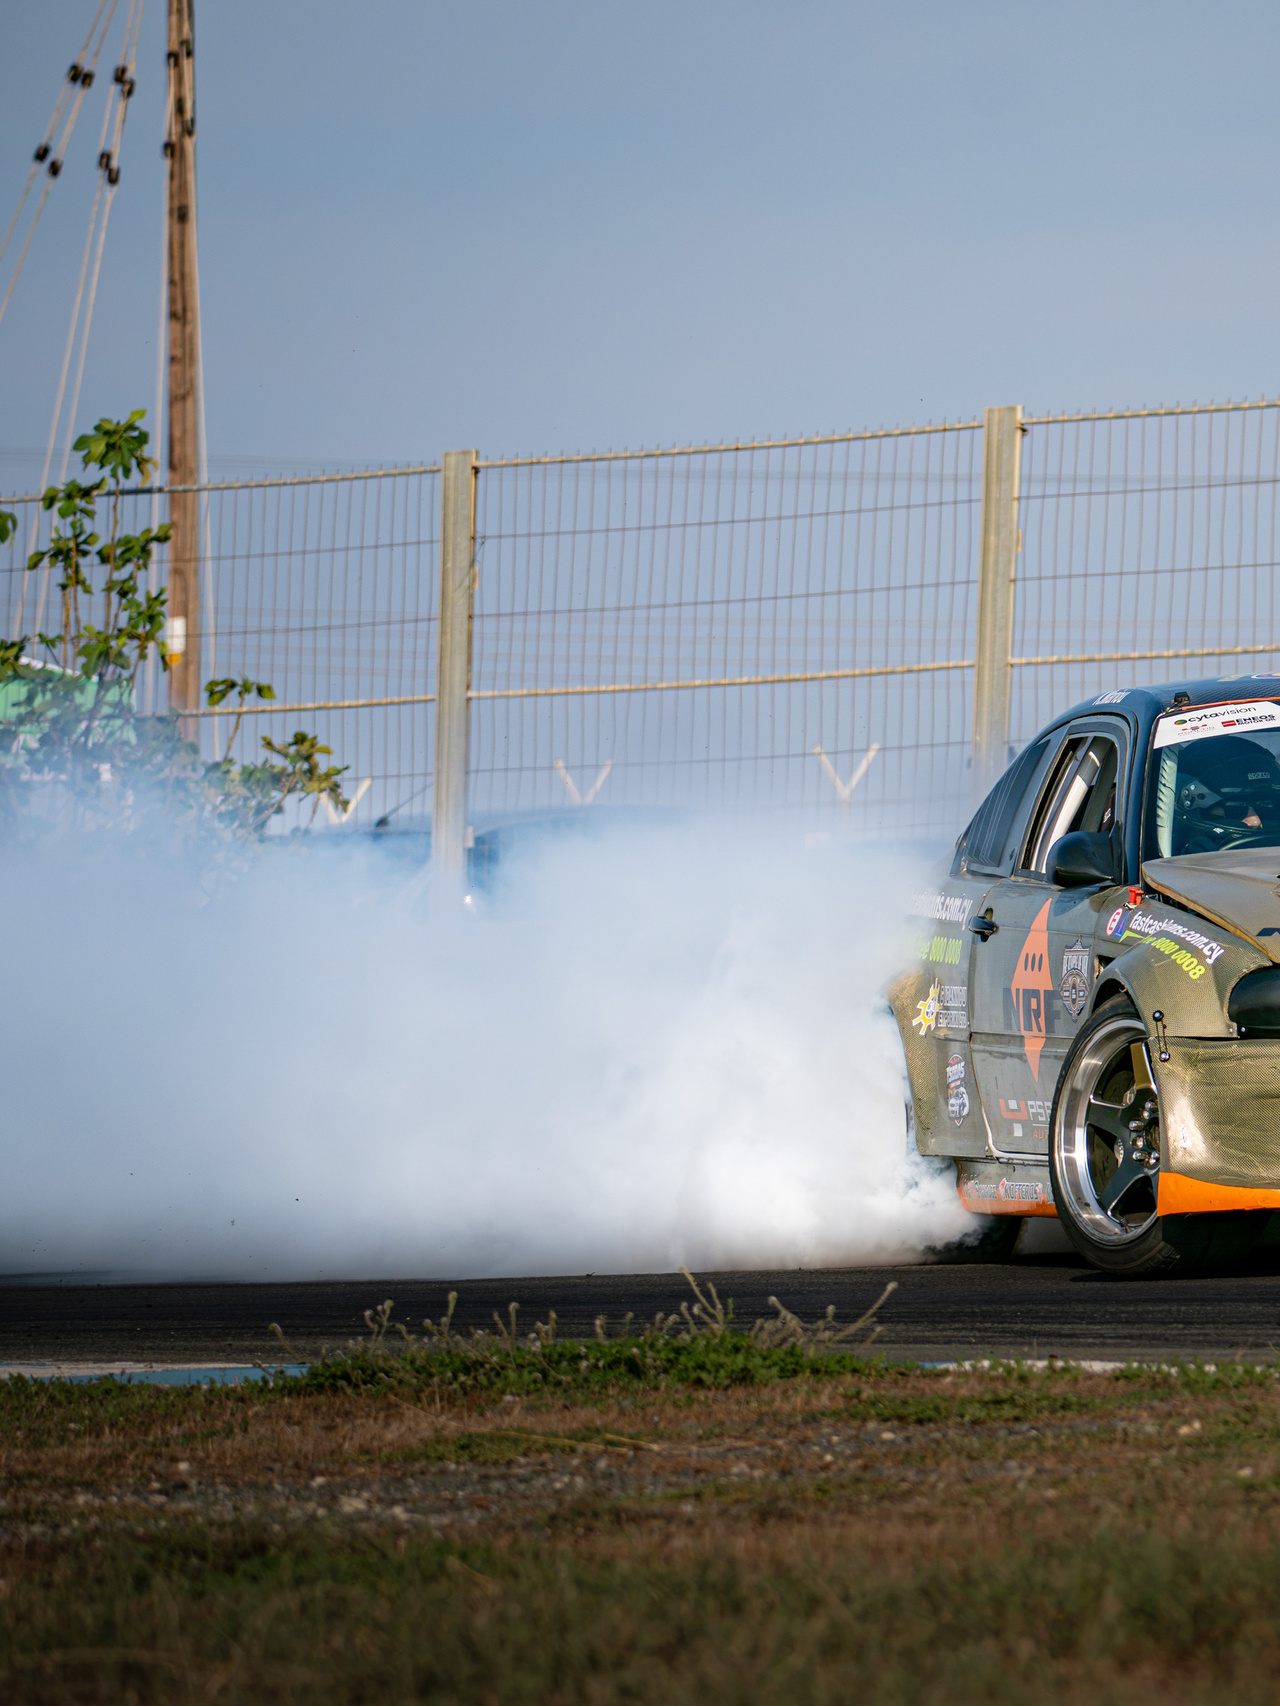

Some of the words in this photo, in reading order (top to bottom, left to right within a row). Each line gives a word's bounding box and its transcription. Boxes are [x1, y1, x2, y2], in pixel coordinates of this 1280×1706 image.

[1188, 707, 1256, 722] cytavision
[1236, 714, 1276, 723] ENEOS
[1171, 950, 1205, 979] 0008
[1003, 988, 1061, 1034] NRF
